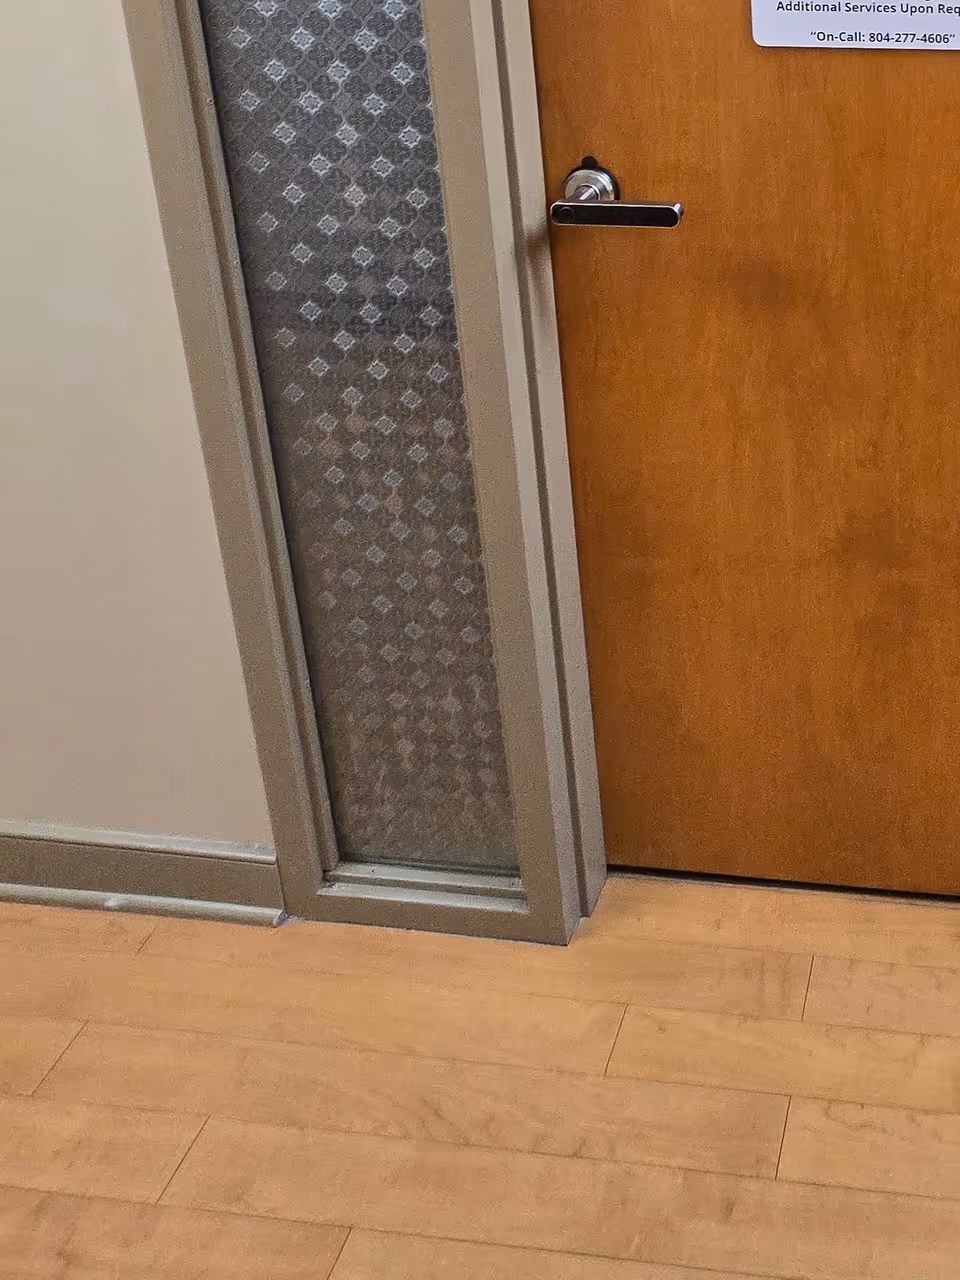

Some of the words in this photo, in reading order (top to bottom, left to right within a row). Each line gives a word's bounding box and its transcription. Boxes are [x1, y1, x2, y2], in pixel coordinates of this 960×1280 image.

[777, 2, 841, 12] Additional
[845, 2, 896, 13] Services
[901, 4, 933, 16] Upon
